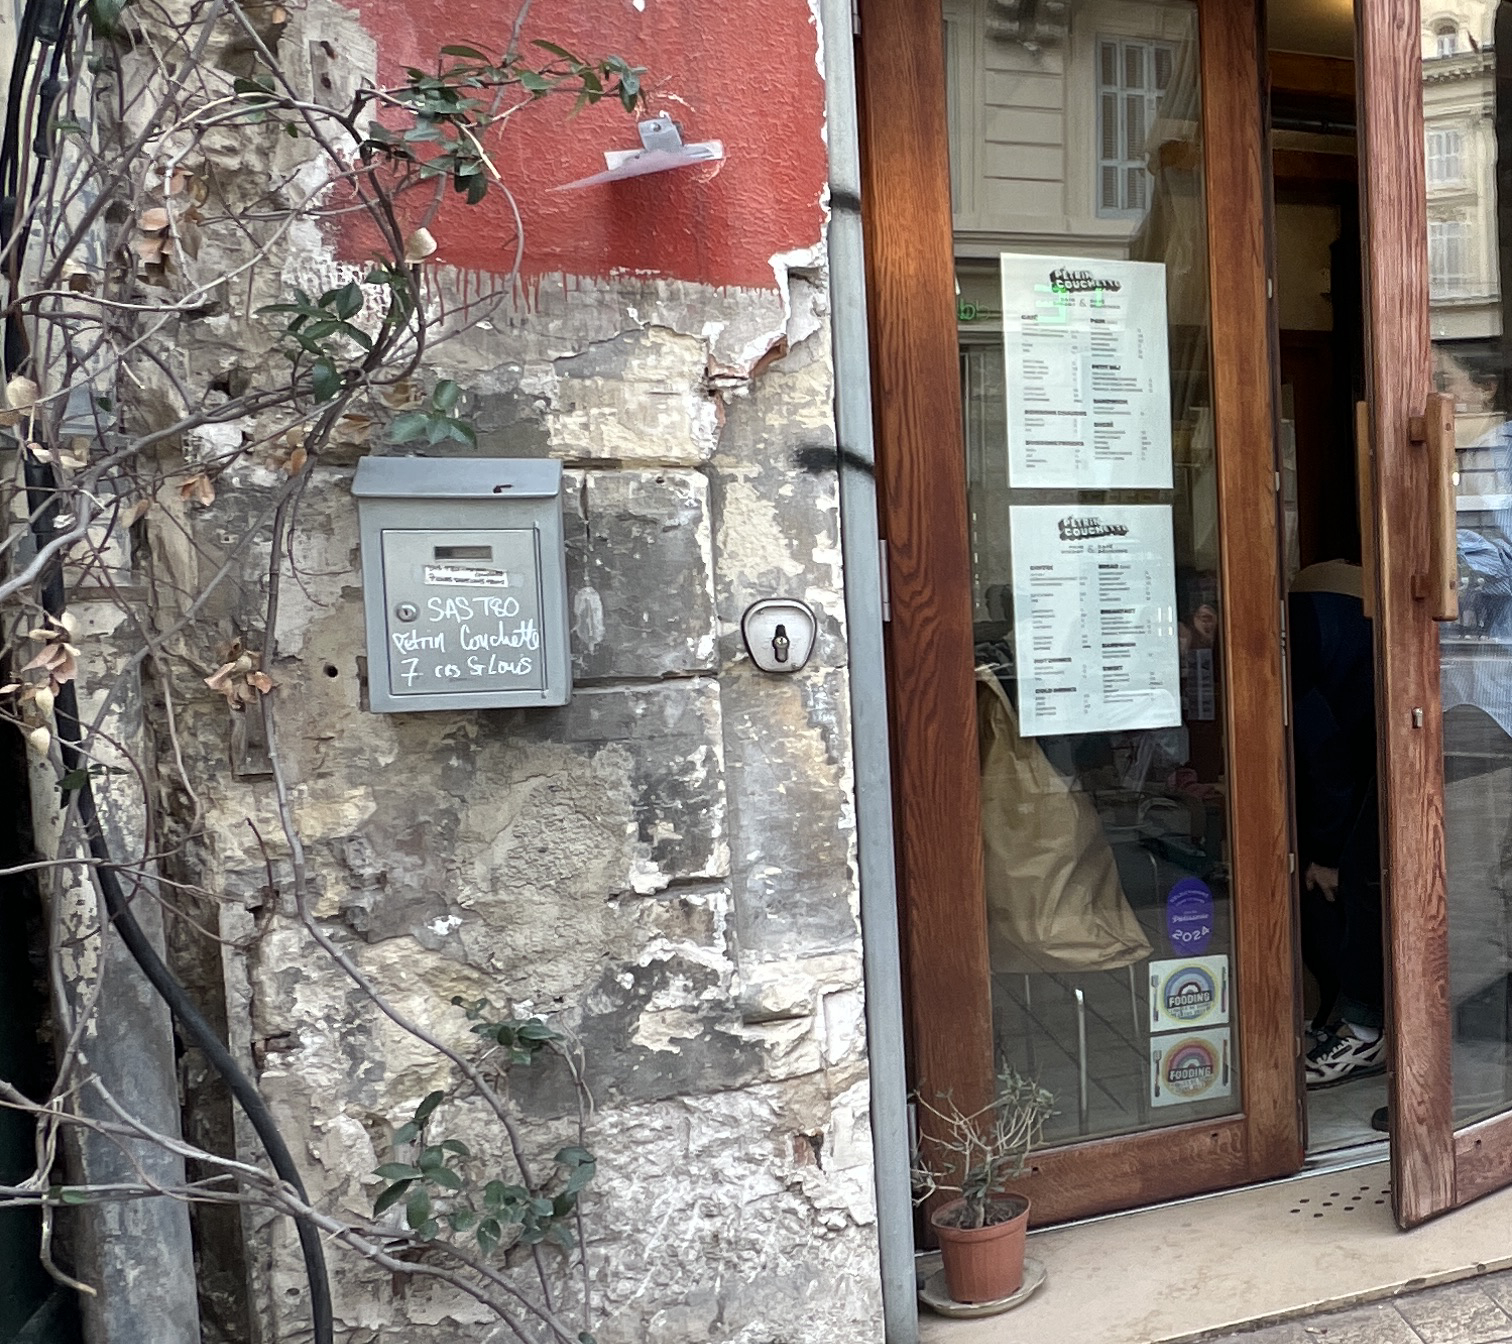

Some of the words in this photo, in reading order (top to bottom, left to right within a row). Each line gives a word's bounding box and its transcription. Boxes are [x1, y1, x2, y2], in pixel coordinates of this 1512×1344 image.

[401, 657, 424, 687] 7
[1171, 925, 1211, 942] 2024
[1168, 991, 1211, 1008] FOODING
[1169, 1066, 1211, 1081] FOODING
